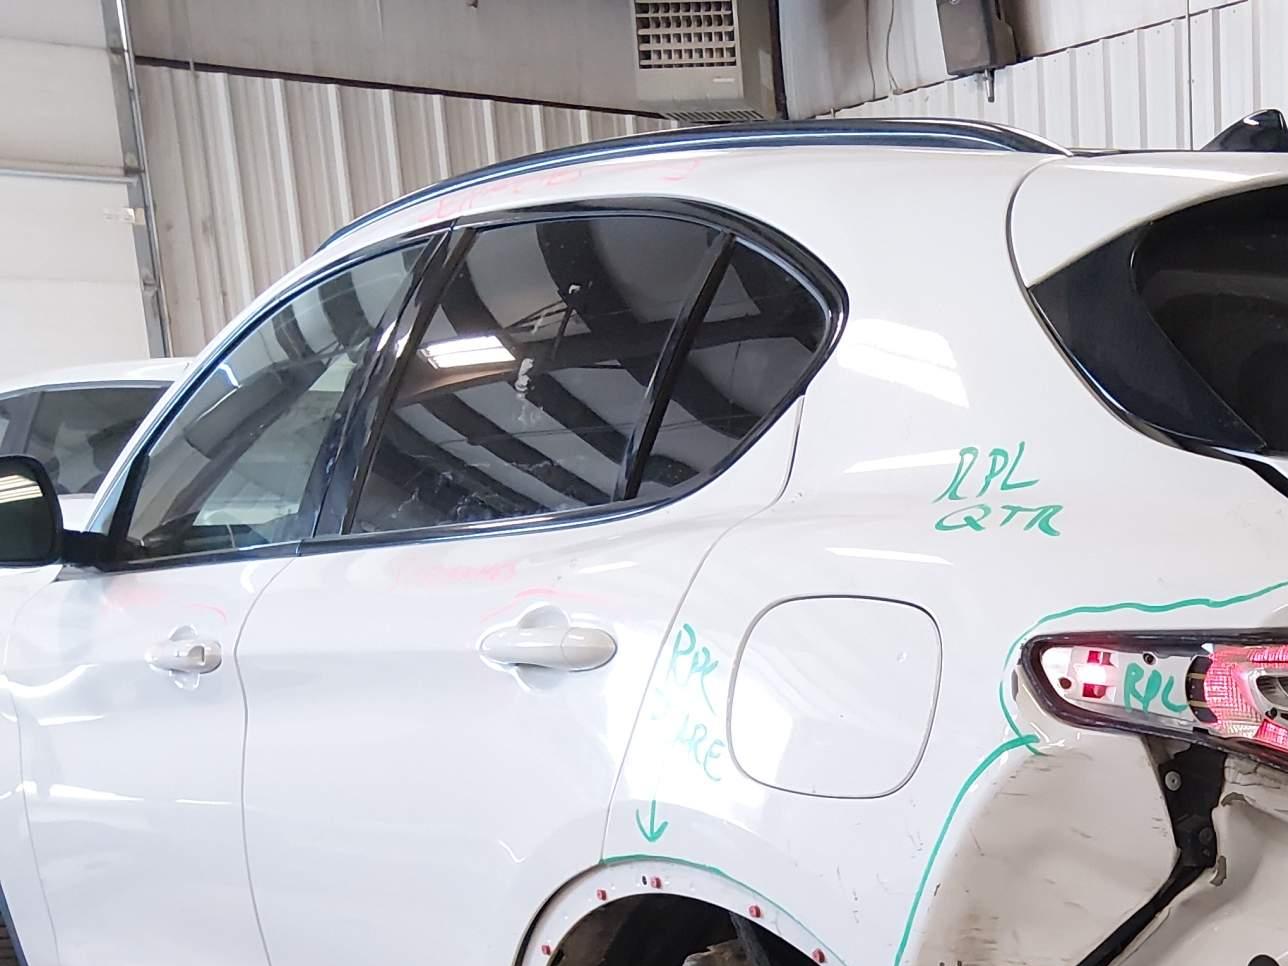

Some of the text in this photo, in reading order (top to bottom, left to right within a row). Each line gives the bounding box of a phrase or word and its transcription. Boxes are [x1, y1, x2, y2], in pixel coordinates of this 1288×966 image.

[933, 440, 1039, 503] RPL
[934, 503, 1064, 537] QTR
[1123, 662, 1189, 715] RPL
